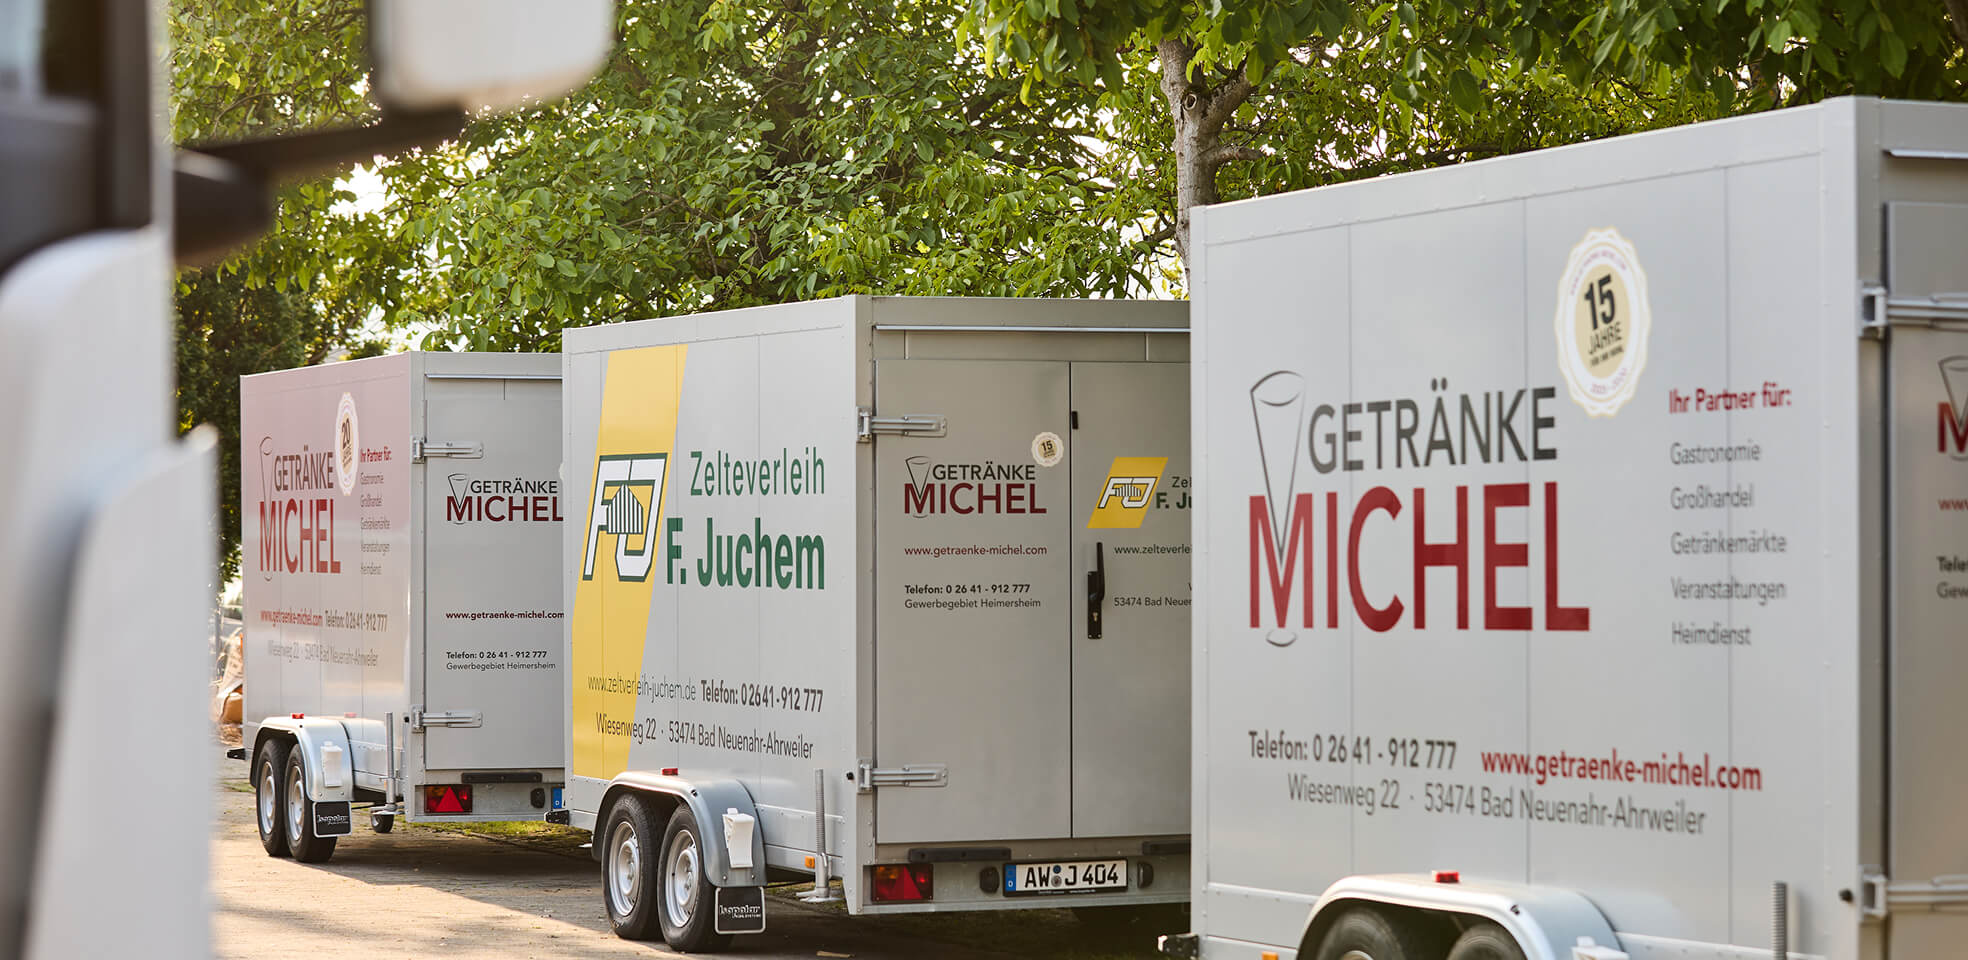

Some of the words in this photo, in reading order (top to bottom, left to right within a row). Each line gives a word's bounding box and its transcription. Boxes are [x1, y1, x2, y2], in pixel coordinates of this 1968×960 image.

[1584, 274, 1616, 330] 15
[1589, 322, 1623, 355] JAHRE
[1669, 388, 1690, 414] Ihr
[1696, 387, 1756, 412] Partner
[1762, 381, 1792, 408] für:
[342, 418, 351, 449] 20
[1308, 377, 1557, 474] GETRÄNKE
[1042, 440, 1053, 451] 15
[1670, 439, 1760, 464] Gastronomie
[274, 444, 334, 491] GETRÄNKE
[690, 446, 825, 496] Zelteverleih
[933, 461, 1036, 480] GETRÄNKE
[470, 477, 558, 494] GETRÄNKE
[905, 482, 1047, 515] MICHEL
[1670, 484, 1754, 510] Großhandel
[446, 495, 564, 522] MICHEL
[1156, 492, 1169, 509] F.
[260, 498, 341, 575] MICHEL
[1670, 529, 1787, 556] Getränkemärkte
[667, 517, 687, 585] F.
[697, 517, 825, 590] Juchem
[904, 544, 1048, 558] www.getraenke-michel.com
[1249, 481, 1590, 633] MICHEL
[904, 584, 943, 595] Telefon:
[946, 584, 952, 594] 0
[955, 584, 968, 594] 26
[970, 584, 982, 594] 41
[991, 584, 1010, 594] 912
[1012, 583, 1031, 594] 777
[1114, 597, 1142, 607] 53474
[1144, 597, 1162, 607] Bad
[1671, 577, 1787, 607] Veranstaltungen
[446, 610, 564, 620] www.getraenke-michel.com
[904, 599, 978, 610] Gewerbegebiet
[981, 598, 1041, 608] Heimersheim
[1672, 622, 1751, 645] Heimdienst
[446, 651, 477, 659] Telefon:
[479, 651, 484, 659] 0
[486, 651, 497, 659] 26
[532, 650, 548, 658] 777
[446, 662, 505, 671] Gewerbegebiet
[587, 671, 696, 703] www.zeltverleih-juchem.de
[701, 679, 738, 705] Telefon:
[803, 688, 823, 713] 777
[596, 712, 644, 745] Wiesenweg
[646, 718, 656, 740] 22
[669, 720, 695, 744] 53474
[699, 723, 715, 748] Bad
[719, 725, 814, 759] Neuenahr-Ahrweiler
[1248, 730, 1308, 760] Telefon:
[1313, 734, 1323, 763] 0
[1328, 735, 1347, 764] 26
[1352, 737, 1371, 765] 41
[1388, 738, 1419, 768] 912
[1425, 740, 1457, 770] 777
[1481, 748, 1763, 791] www.getraenke-michel.com
[1287, 773, 1375, 816] Wiesenweg
[1380, 779, 1400, 809] 22
[1424, 782, 1475, 815] 53474
[1481, 786, 1513, 818] Bad
[1520, 789, 1706, 834] Neuenahr-Ahrweiler
[1025, 866, 1050, 888] AW
[1065, 865, 1077, 886] J
[1082, 863, 1119, 885] 404
